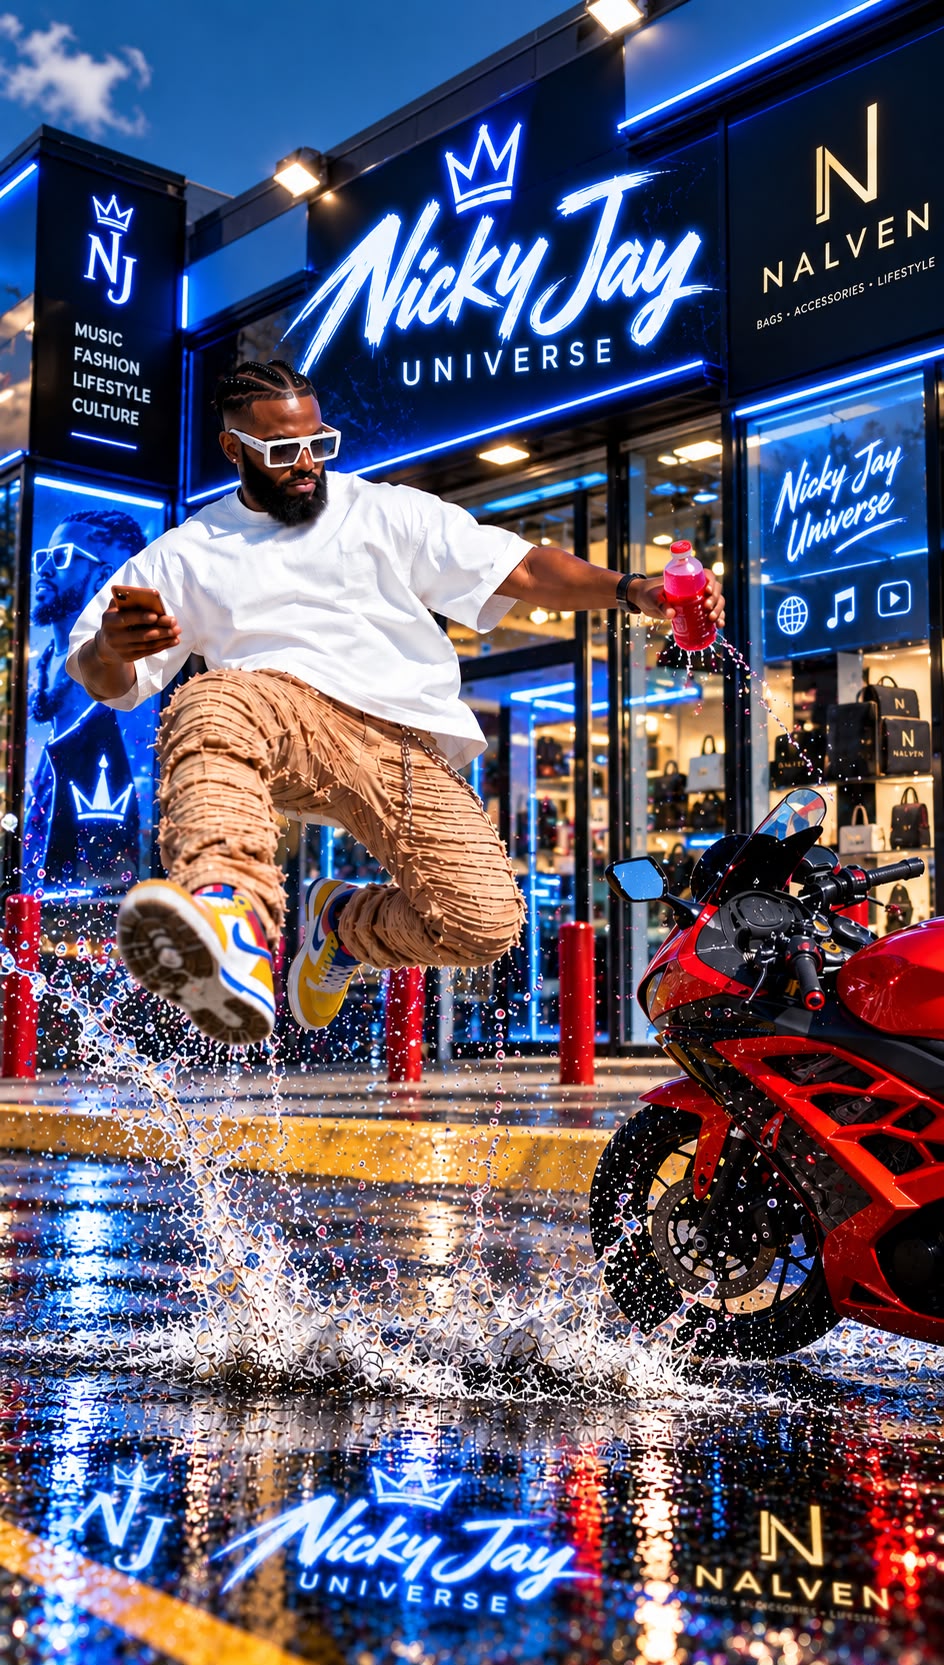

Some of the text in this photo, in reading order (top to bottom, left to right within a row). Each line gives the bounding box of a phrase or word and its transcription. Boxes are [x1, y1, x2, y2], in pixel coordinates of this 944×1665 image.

[763, 202, 931, 294] NALVEN
[284, 170, 720, 377] Nicky Jay
[756, 257, 936, 330] BAGS ACCESSORIES LIFESTYLE
[74, 322, 123, 349] MUSIC
[74, 346, 141, 377] FASHION
[402, 338, 612, 386] UNIVERSE
[73, 371, 151, 404] LIFESTYLE
[72, 397, 140, 427] CULTURE
[772, 438, 905, 535] Nicky Jay
[786, 491, 895, 562] Universe
[901, 729, 915, 748] N
[209, 1494, 600, 1601] Nicky Jay
[299, 1571, 508, 1614] UNIVERSE
[695, 1565, 890, 1611] NALVEN
